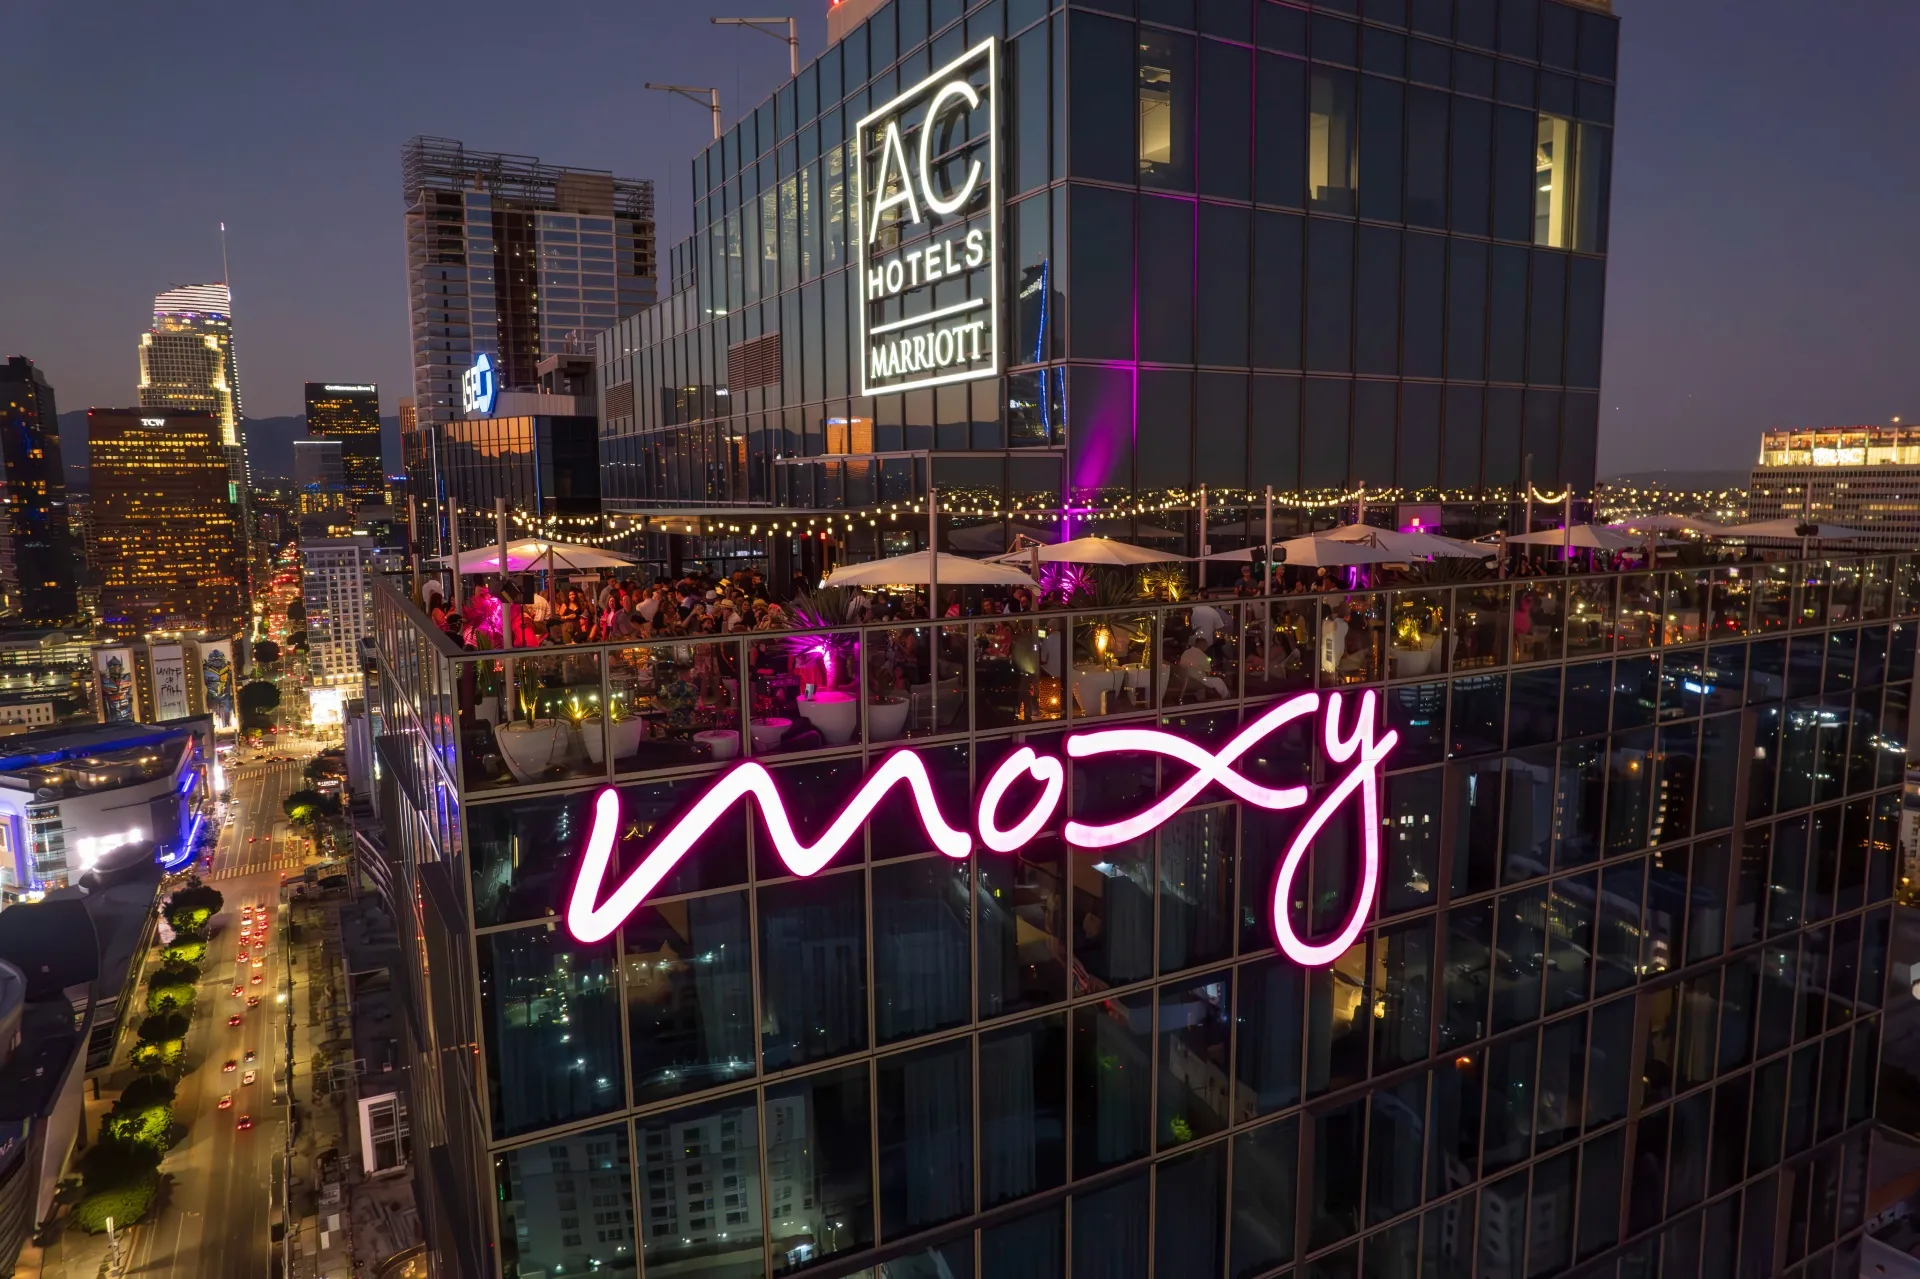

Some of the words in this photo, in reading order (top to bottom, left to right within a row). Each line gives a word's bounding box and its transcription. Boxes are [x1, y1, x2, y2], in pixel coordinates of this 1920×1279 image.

[868, 80, 982, 244] AC
[868, 229, 984, 300] HOTELS
[870, 320, 984, 379] MARRIOTT
[141, 418, 165, 427] TCW
[156, 667, 182, 676] UNITE
